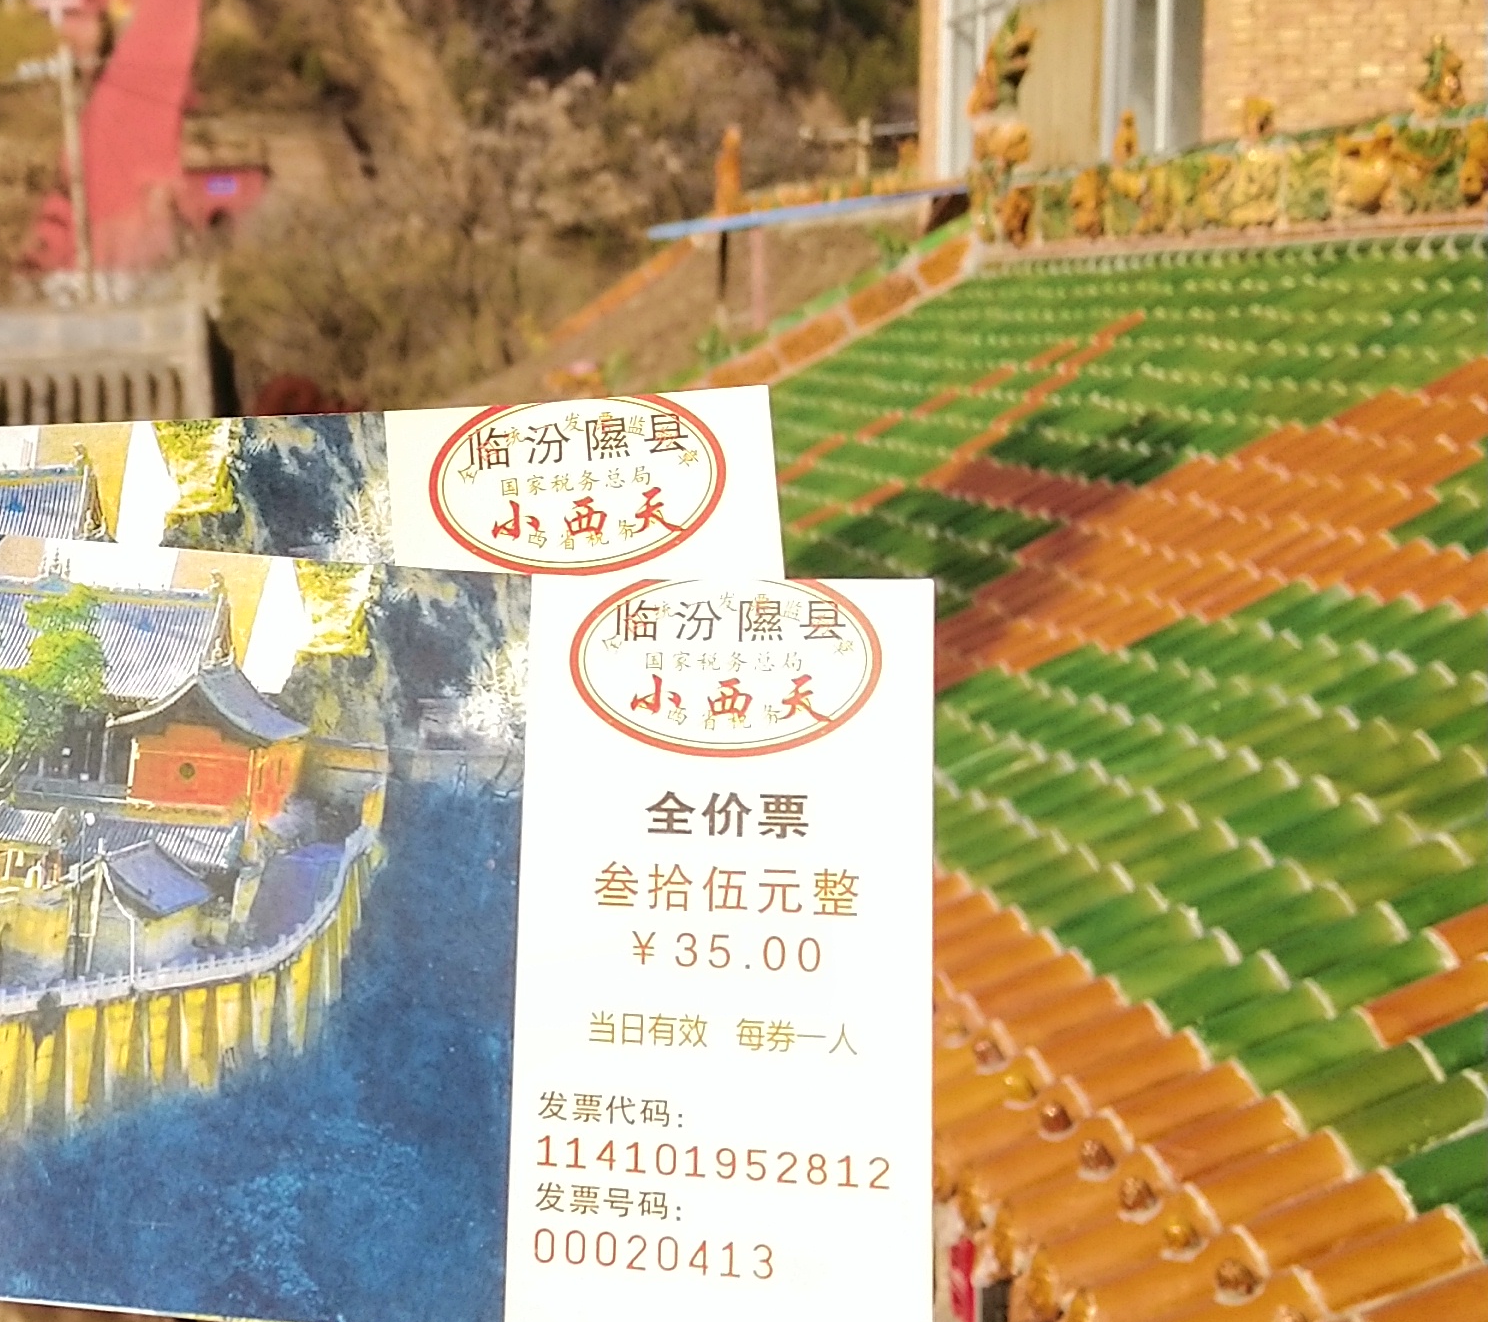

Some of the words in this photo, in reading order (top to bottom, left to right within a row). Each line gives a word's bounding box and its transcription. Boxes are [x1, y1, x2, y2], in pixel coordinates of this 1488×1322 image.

[466, 412, 690, 471] 临汾隰县
[500, 464, 652, 497] 国家税务总局
[491, 486, 686, 539] 小西天
[615, 597, 847, 643] 临汾隰县
[644, 650, 803, 673] 国家税务总局
[630, 674, 832, 722] 小西天
[645, 790, 810, 839] 全价票
[594, 861, 860, 917] 叁拾伍元整
[588, 1010, 707, 1047] 当日有效
[736, 1018, 858, 1055] 每券一人
[536, 1135, 891, 1190] 114101952812
[533, 1228, 775, 1280] 00020413
